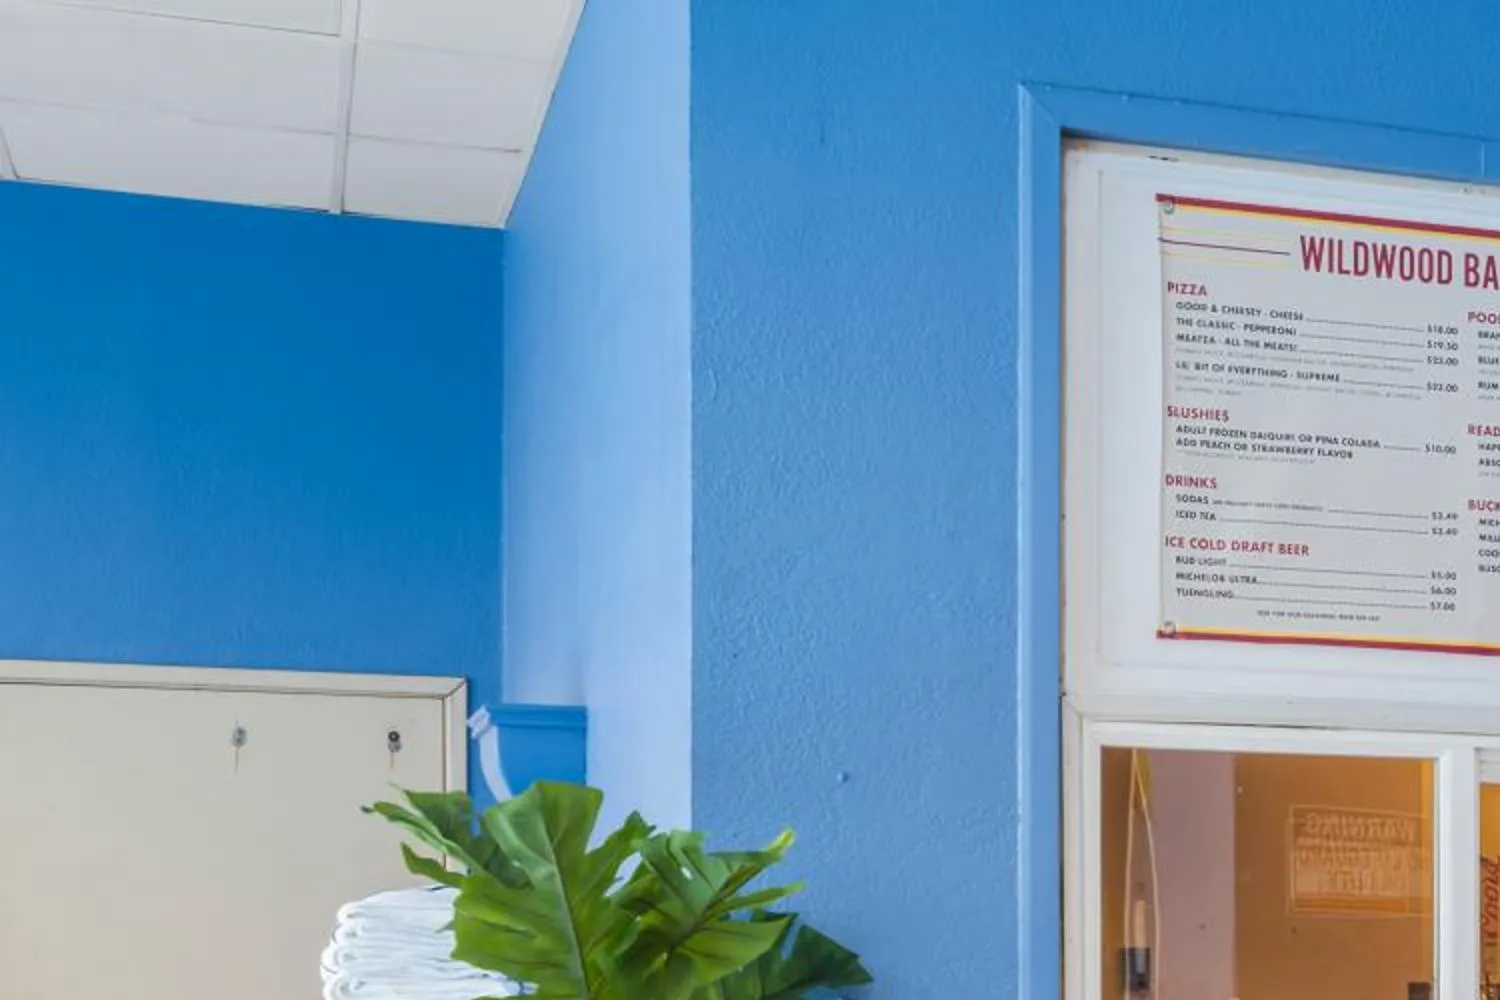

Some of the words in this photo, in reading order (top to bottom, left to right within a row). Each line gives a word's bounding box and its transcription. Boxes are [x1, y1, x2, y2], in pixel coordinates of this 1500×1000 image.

[1300, 234, 1453, 286] WILDWOOD
[1167, 281, 1207, 296] PIZZA
[1175, 301, 1208, 311] GOOD
[1176, 317, 1193, 327] THE
[1243, 323, 1297, 336] PEPPERONI
[1244, 339, 1260, 349] THE
[1478, 355, 1500, 366] BLUE
[1227, 364, 1289, 379] EVERYTHING
[1297, 370, 1340, 383] SUPREME
[1167, 405, 1230, 422] SLUSHIES
[1175, 425, 1208, 435] ADULT
[1209, 427, 1248, 439] FROZEN
[1341, 437, 1382, 449] COLADA
[1175, 437, 1198, 448] ADD
[1165, 473, 1218, 489] DRINKS
[1175, 493, 1210, 505] SODAS
[1175, 509, 1198, 520] ICED
[1199, 511, 1217, 521] TEA
[1164, 535, 1186, 549] ICE
[1189, 537, 1227, 551] COLD
[1231, 540, 1274, 554] DRAFT
[1278, 543, 1310, 557] BEER
[1175, 555, 1197, 565] BUD
